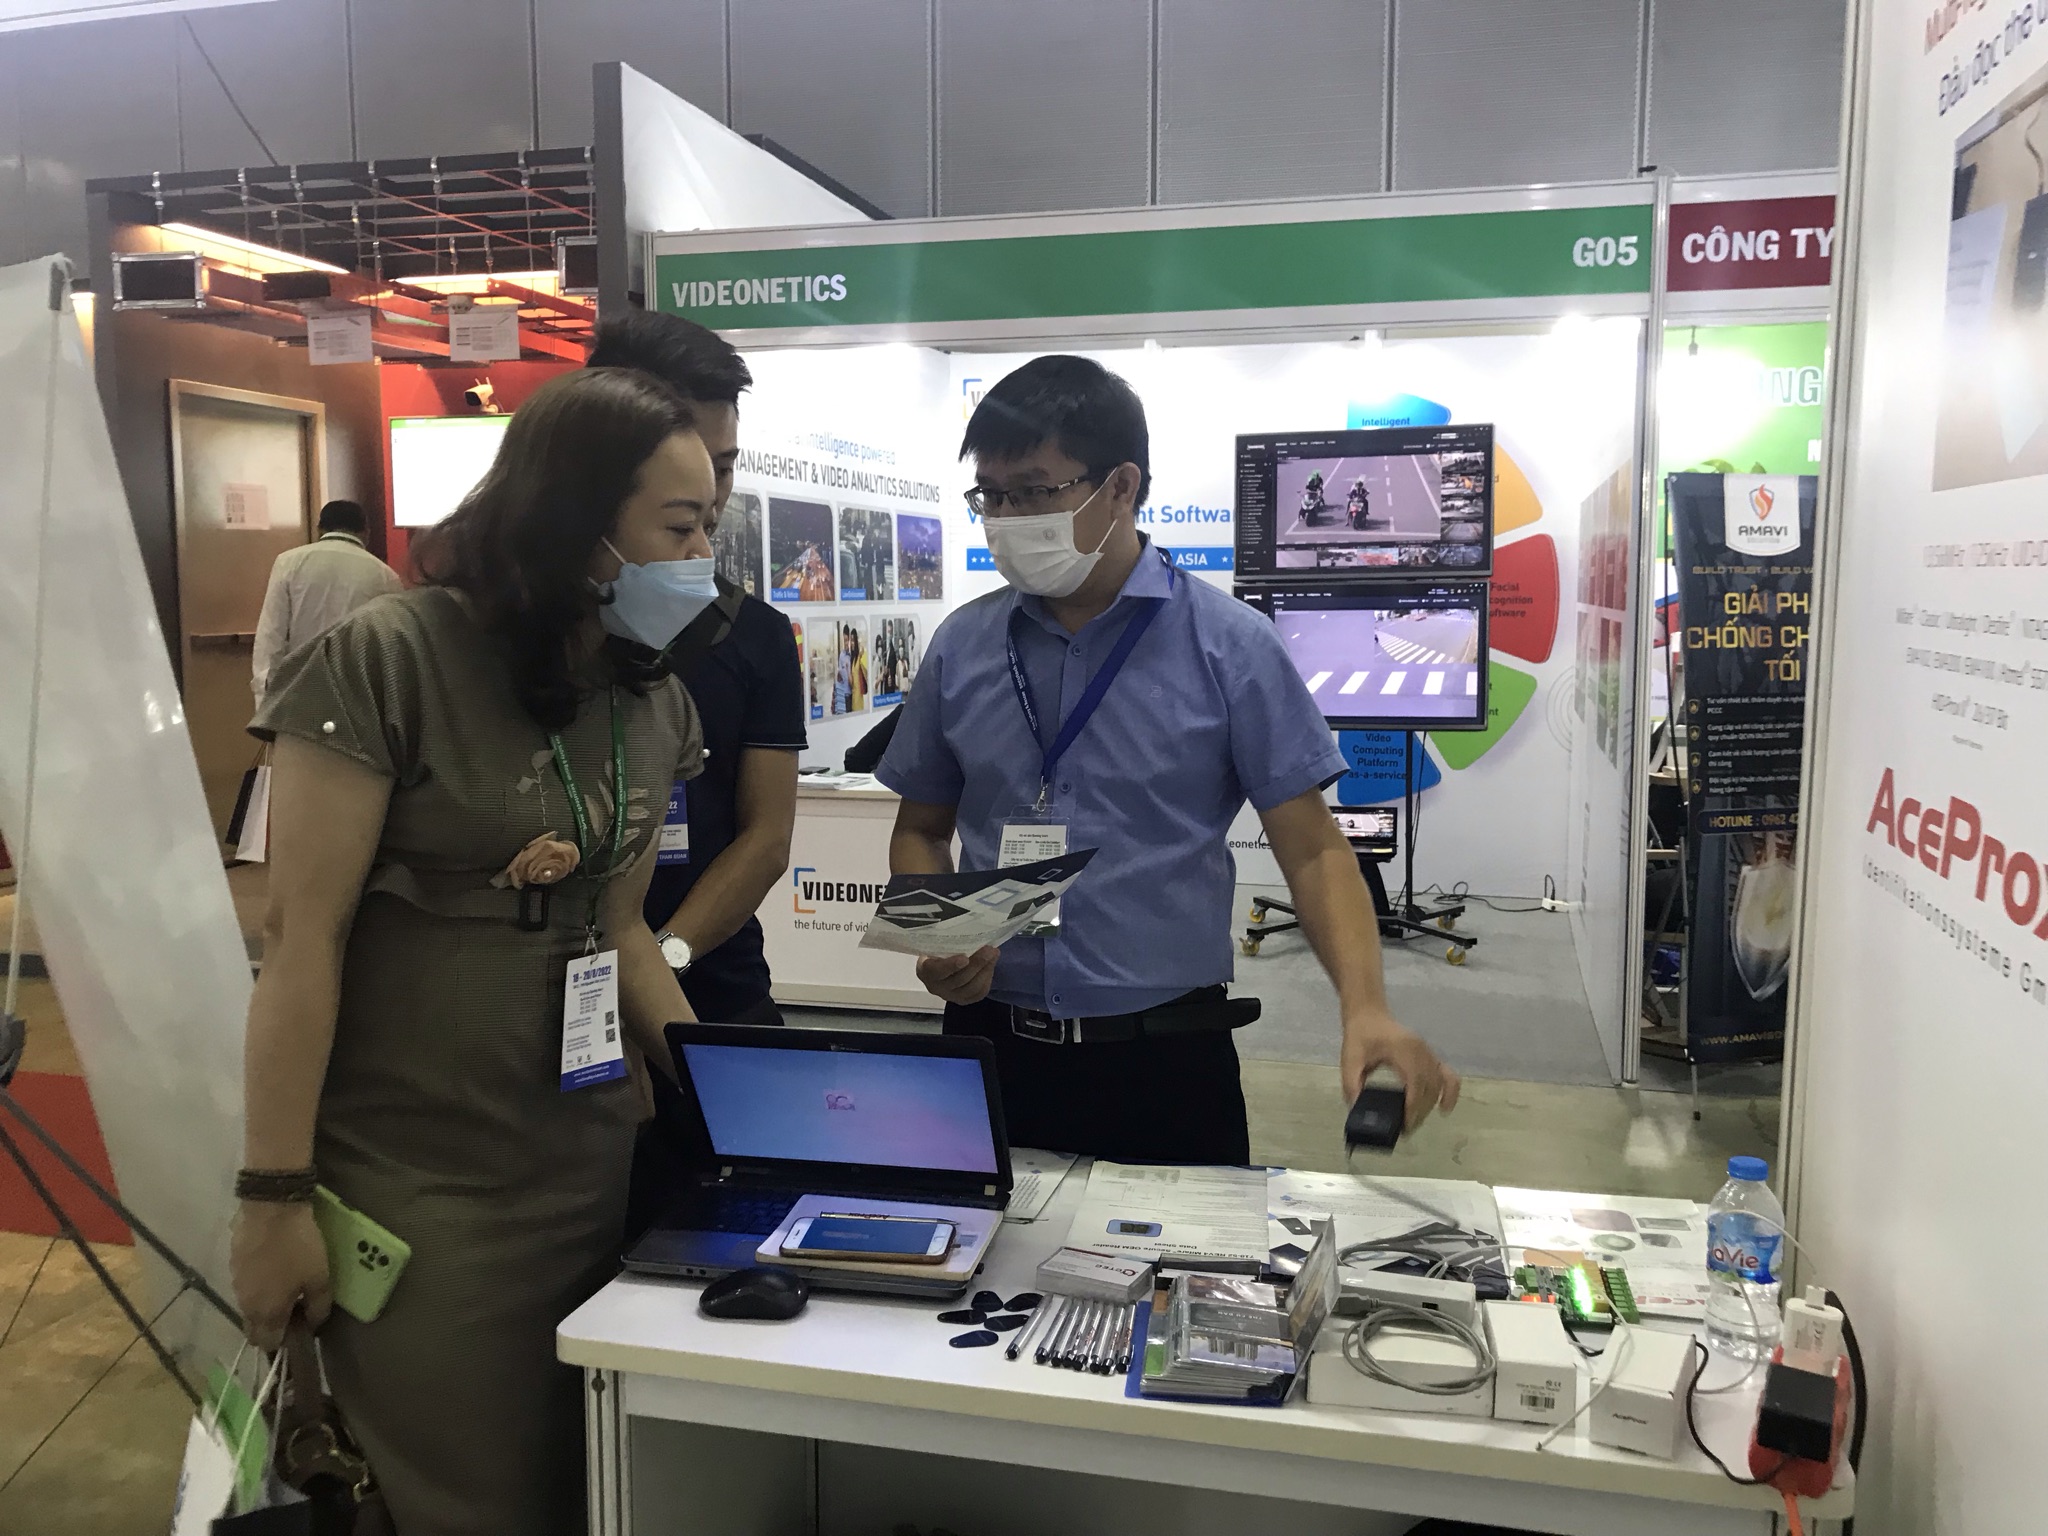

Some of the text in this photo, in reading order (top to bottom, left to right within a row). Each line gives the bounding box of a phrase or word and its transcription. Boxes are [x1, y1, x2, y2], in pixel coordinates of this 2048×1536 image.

[1682, 225, 1836, 263] CÔNG TY
[1572, 235, 1638, 268] G05
[672, 274, 847, 307] VIDEONETICS
[1361, 417, 1410, 428] Intelligent
[811, 462, 819, 485] &
[820, 464, 849, 489] VIDEO
[851, 470, 897, 497] ANALYTICS
[899, 478, 940, 503] SOLUTIONS
[1161, 505, 1233, 524] Softwa
[1738, 525, 1789, 537] AMAVI
[1176, 553, 1208, 566] ASIA
[1489, 596, 1533, 608] cognition
[1724, 584, 1811, 615] GIẢI PH
[1489, 609, 1527, 618] oftware
[1686, 617, 1773, 649] CHỐNG
[1764, 650, 1800, 681] TỐI
[1365, 734, 1391, 743] Video
[1352, 745, 1404, 757] Computing
[1357, 758, 1399, 768] Platform
[1709, 815, 1753, 828] HOTLINE
[802, 881, 888, 903] VIDEONE
[794, 920, 809, 930] the
[812, 920, 841, 932] future
[844, 920, 854, 932] of
